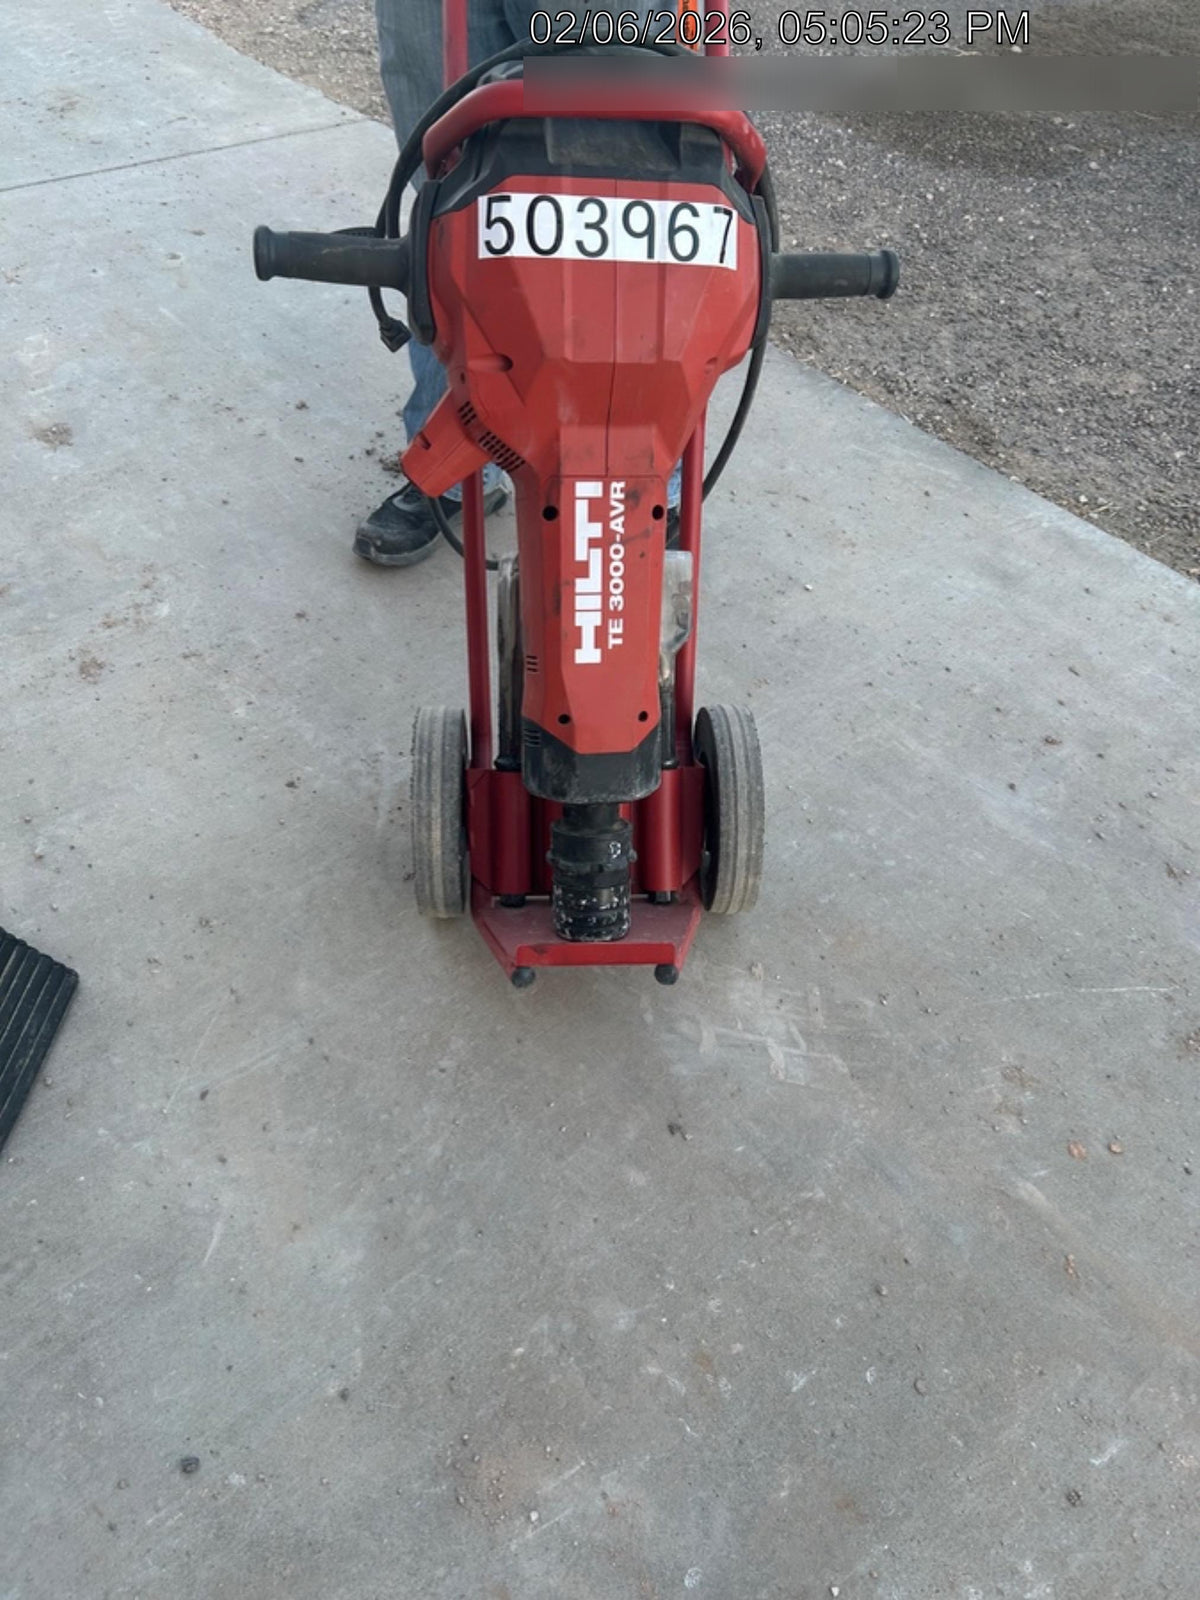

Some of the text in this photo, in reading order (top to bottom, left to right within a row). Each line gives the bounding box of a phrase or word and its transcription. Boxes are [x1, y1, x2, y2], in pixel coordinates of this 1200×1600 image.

[484, 195, 734, 264] 503967
[574, 481, 603, 664] HILTI
[608, 480, 626, 649] TE 3000-AVR
